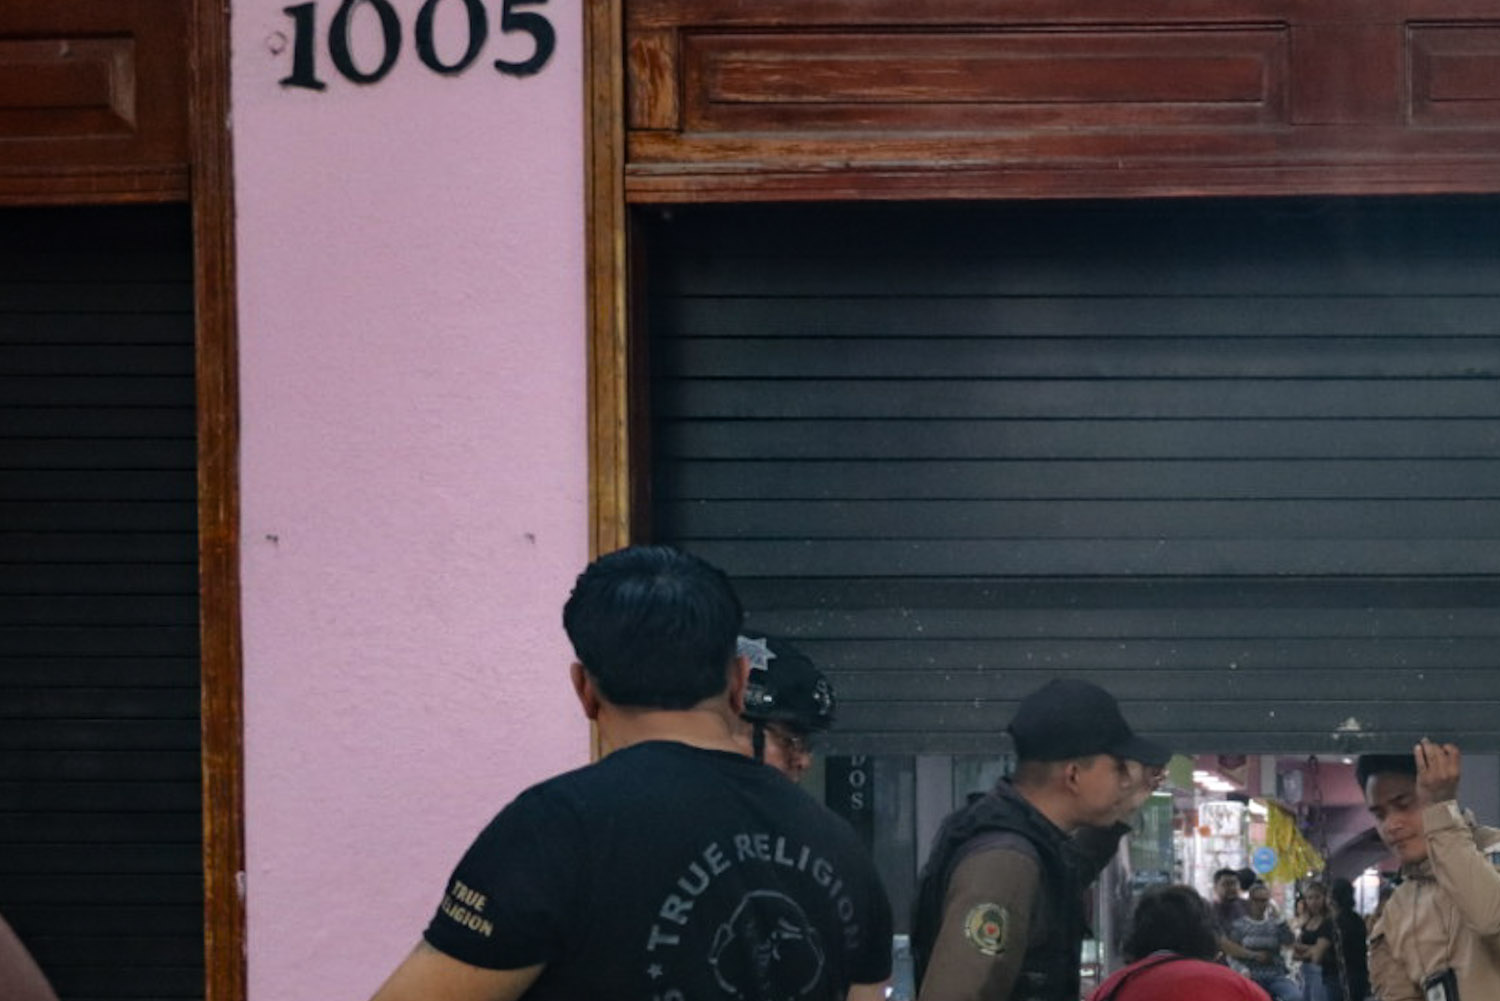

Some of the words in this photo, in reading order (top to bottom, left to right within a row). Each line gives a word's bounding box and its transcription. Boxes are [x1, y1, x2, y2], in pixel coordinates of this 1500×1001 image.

[279, 0, 557, 91] 1005
[452, 881, 488, 912] TRUE
[647, 842, 732, 951] TRUE
[733, 832, 859, 949] RELIGION
